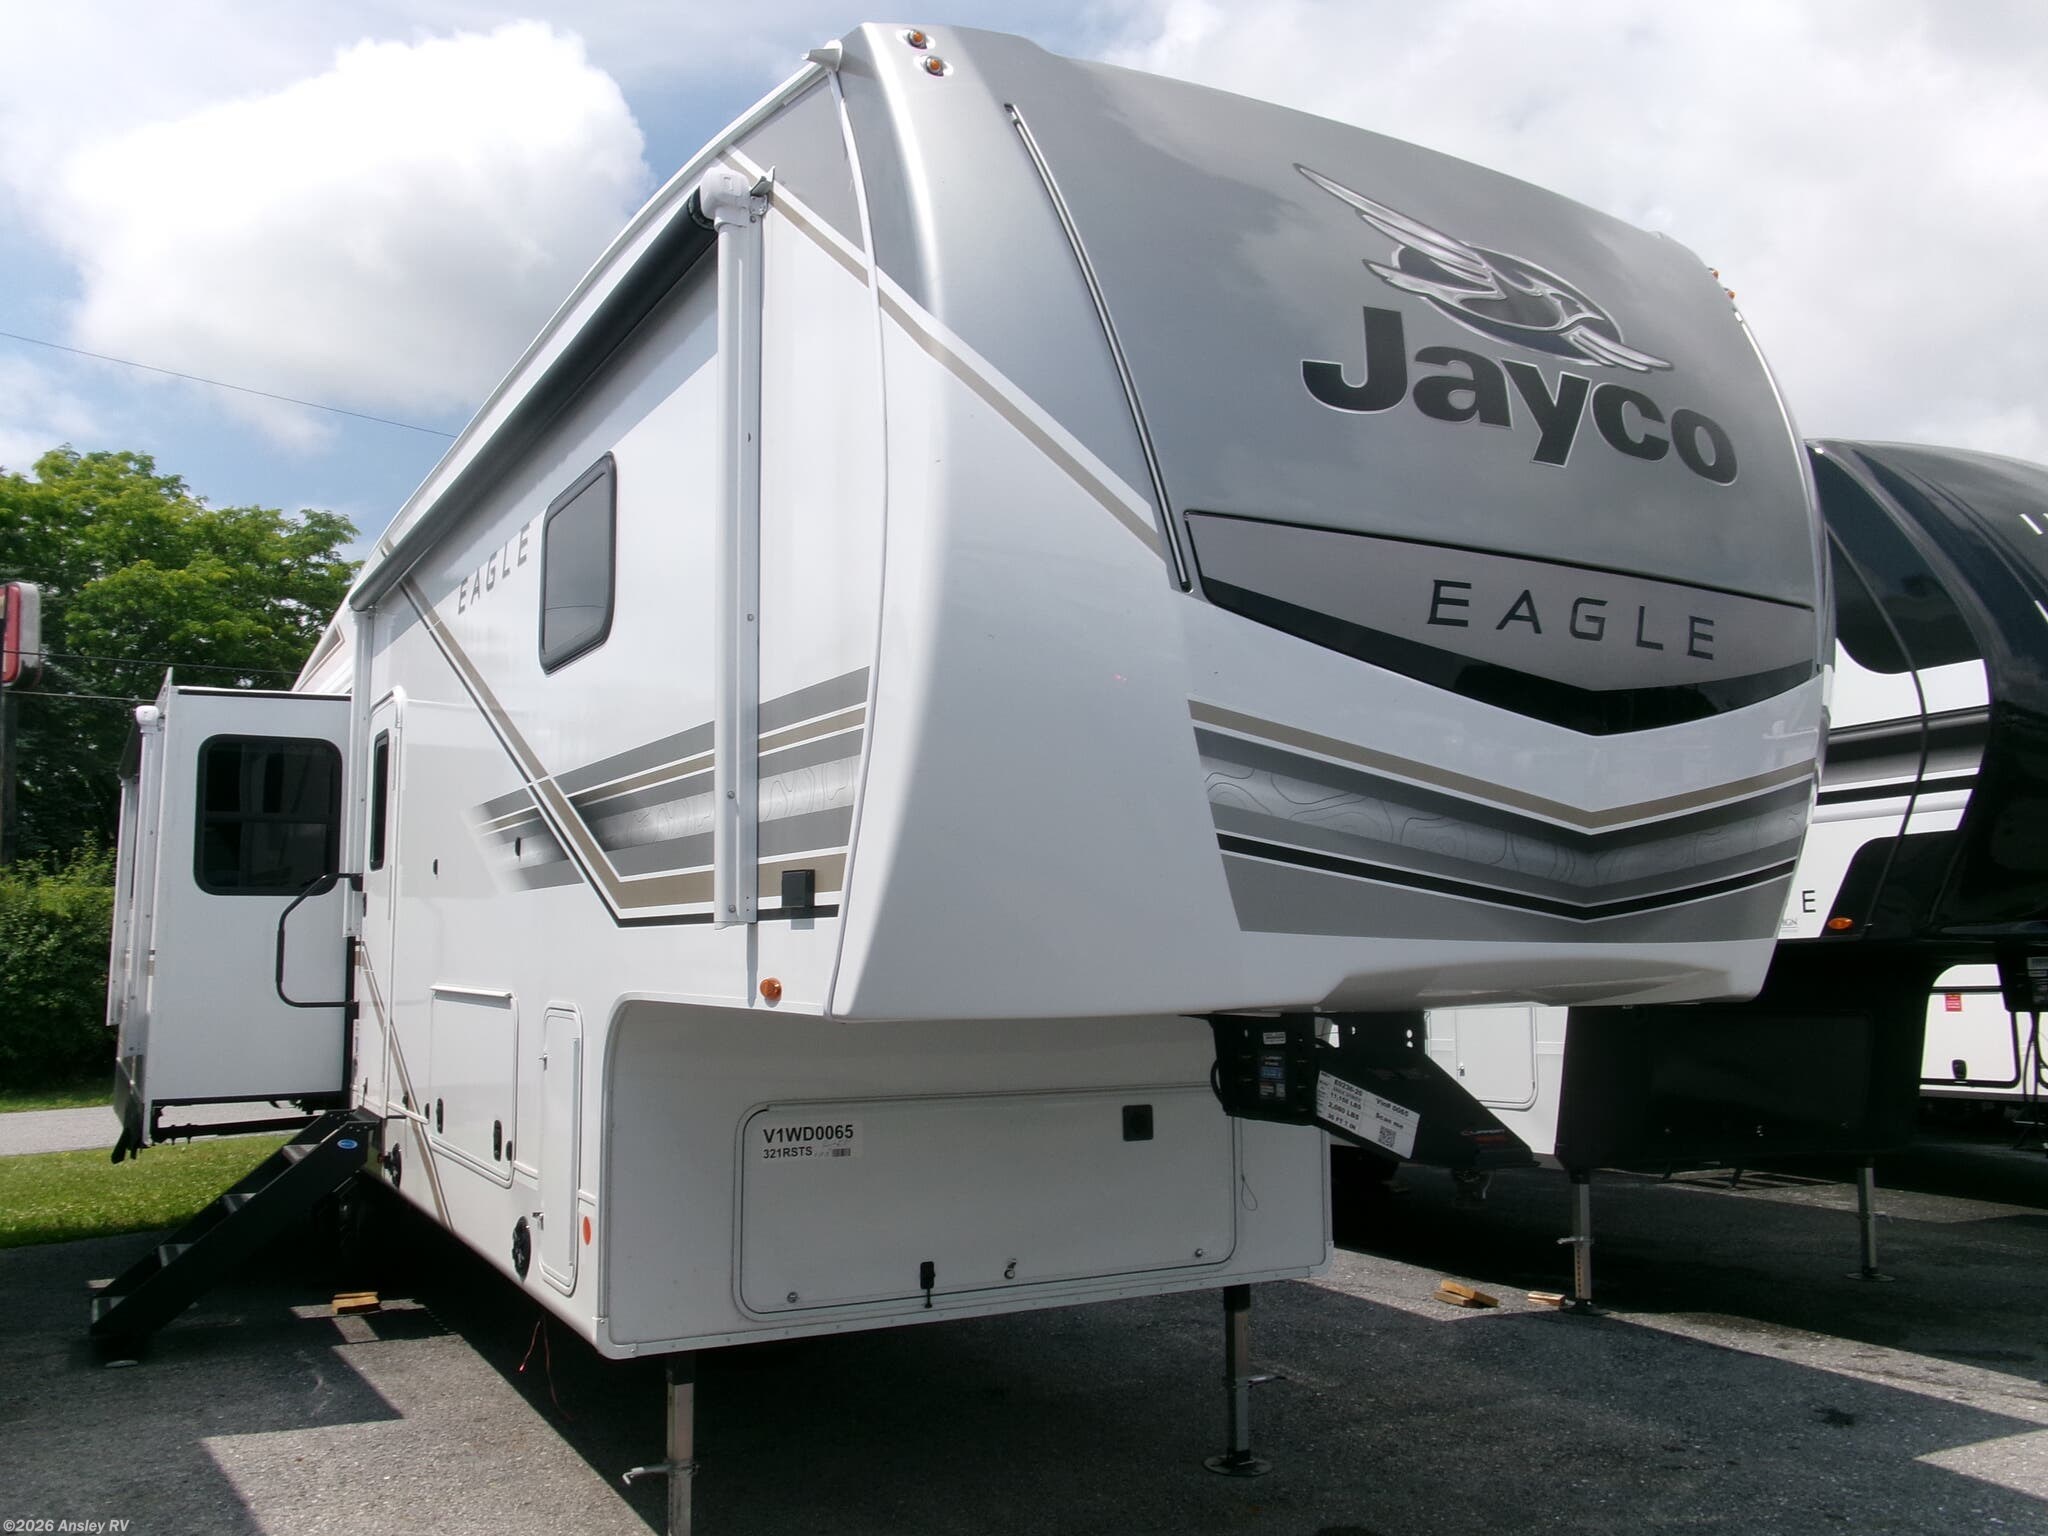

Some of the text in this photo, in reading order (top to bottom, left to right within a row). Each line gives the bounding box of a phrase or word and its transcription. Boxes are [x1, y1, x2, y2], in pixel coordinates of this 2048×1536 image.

[1301, 305, 1738, 486] Jayco
[457, 521, 531, 615] EAGLE
[1427, 579, 1716, 661] EAGLE
[763, 1124, 854, 1143] V1WD0065
[763, 1146, 813, 1159] 321RSTS
